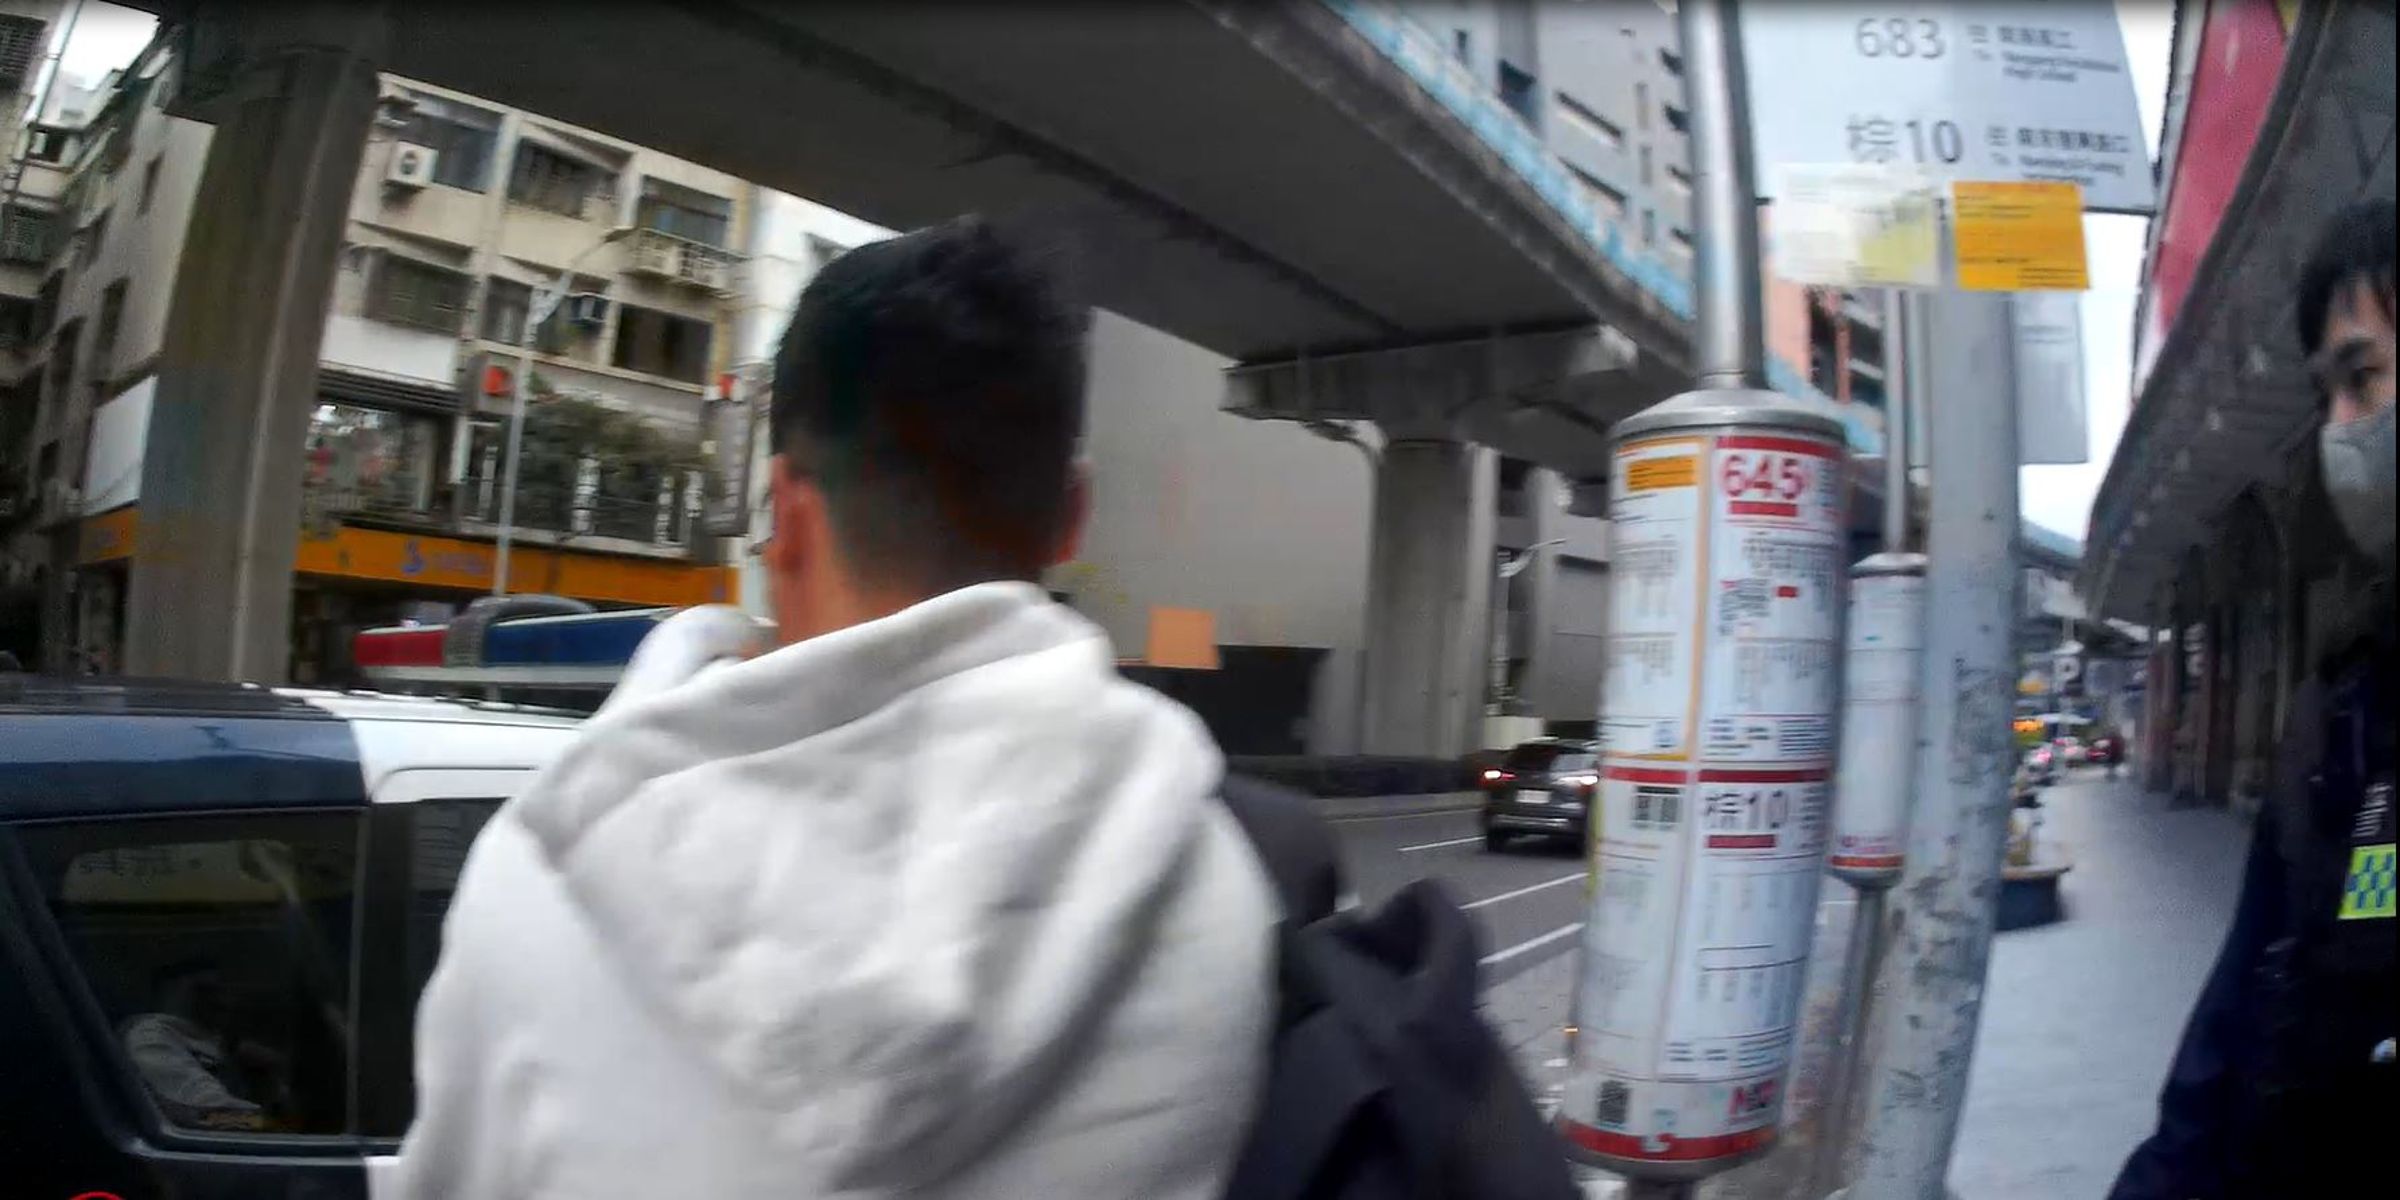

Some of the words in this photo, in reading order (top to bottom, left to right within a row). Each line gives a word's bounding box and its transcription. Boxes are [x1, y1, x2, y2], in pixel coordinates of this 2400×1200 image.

[1856, 17, 1946, 59] 683
[1846, 113, 1964, 165] 棕10
[1722, 454, 1805, 500] 645
